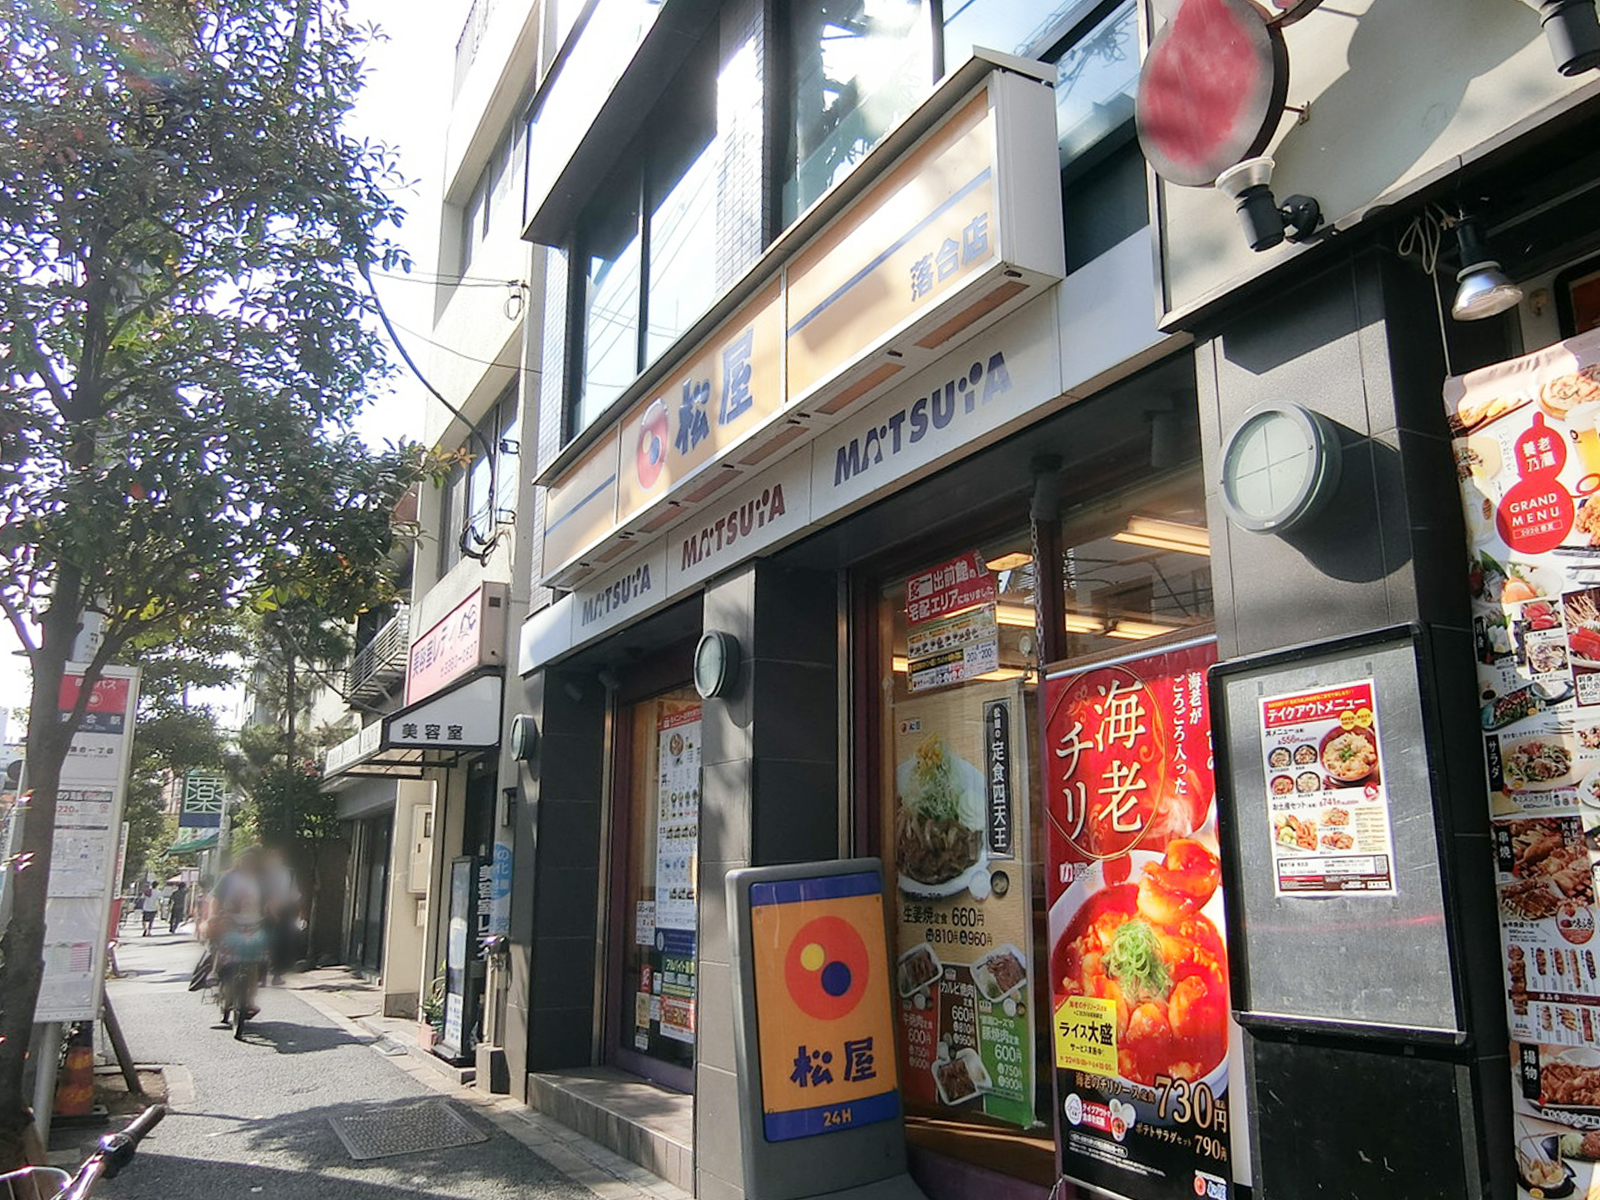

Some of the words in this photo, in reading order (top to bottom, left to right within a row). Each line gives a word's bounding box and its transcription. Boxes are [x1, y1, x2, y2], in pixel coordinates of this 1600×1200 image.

[909, 212, 988, 303] 落合店
[674, 326, 753, 456] 松屋
[833, 350, 1014, 487] MATSUYA
[679, 483, 786, 572] MATSUYA
[1509, 493, 1558, 513] GRAND
[1512, 506, 1560, 527] MENU
[1187, 671, 1203, 726] 海老が
[1267, 698, 1366, 722] テイクアウトメニュー
[402, 723, 463, 741] 美容室
[1093, 679, 1147, 833] 海老
[1172, 674, 1188, 795] ごろごろ入った
[1055, 721, 1094, 841] チリ
[1488, 742, 1500, 779] サラダ
[1059, 1020, 1114, 1046] ライス大盛
[789, 1036, 877, 1088] 松屋
[822, 1107, 852, 1127] 24H
[1135, 1122, 1193, 1148] ポテトサラダセット
